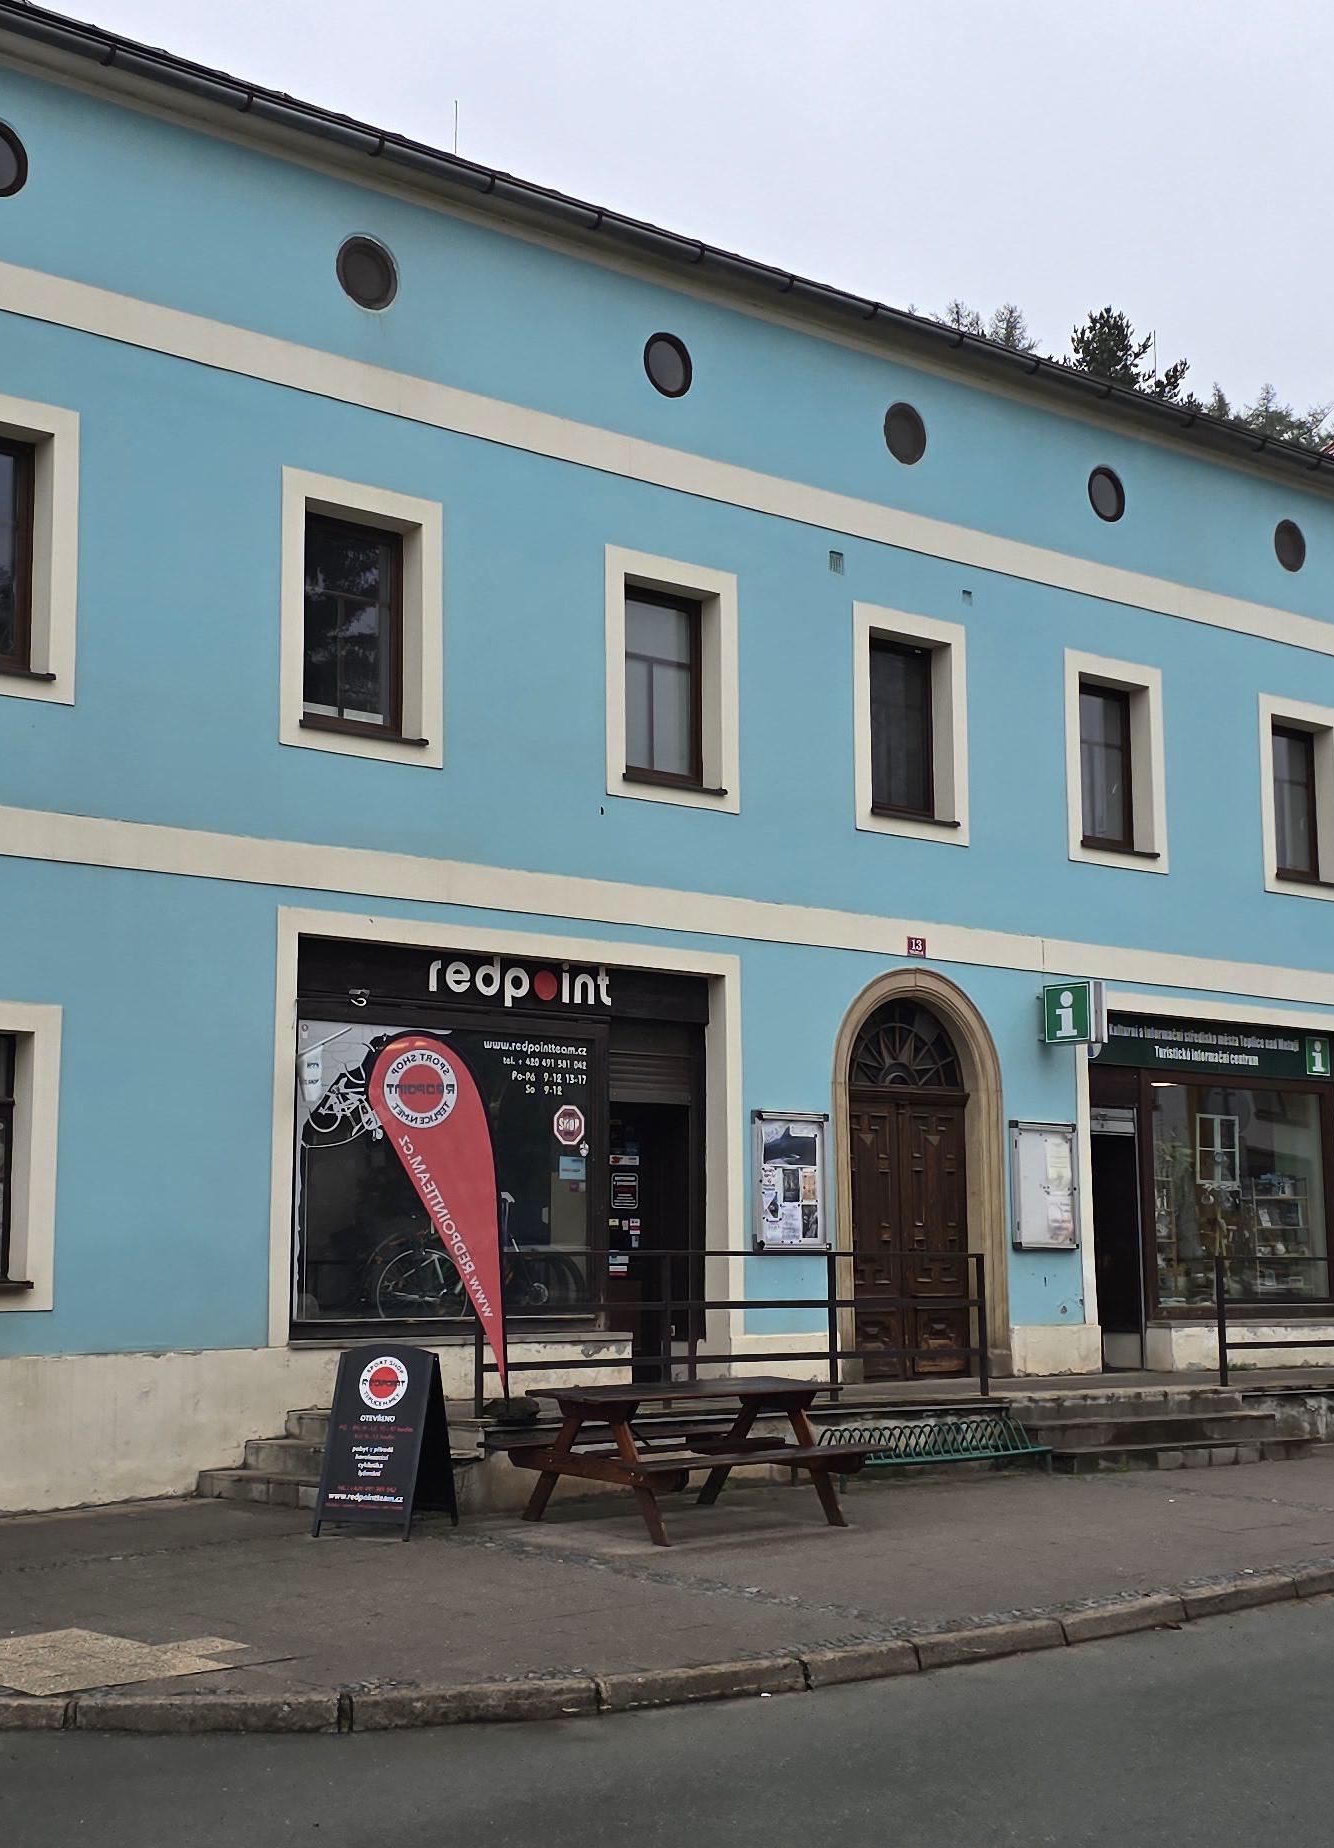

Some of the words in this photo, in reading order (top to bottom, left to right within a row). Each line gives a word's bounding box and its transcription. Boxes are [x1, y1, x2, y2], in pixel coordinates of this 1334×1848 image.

[911, 939, 923, 951] 13
[1139, 1028, 1144, 1038] a
[483, 1040, 587, 1056] www.redpointteam.cz
[525, 1057, 540, 1067] 420
[541, 1058, 555, 1068] 491
[1230, 1053, 1259, 1066] centrum
[525, 1084, 536, 1094] So
[543, 1085, 563, 1096] 9-12
